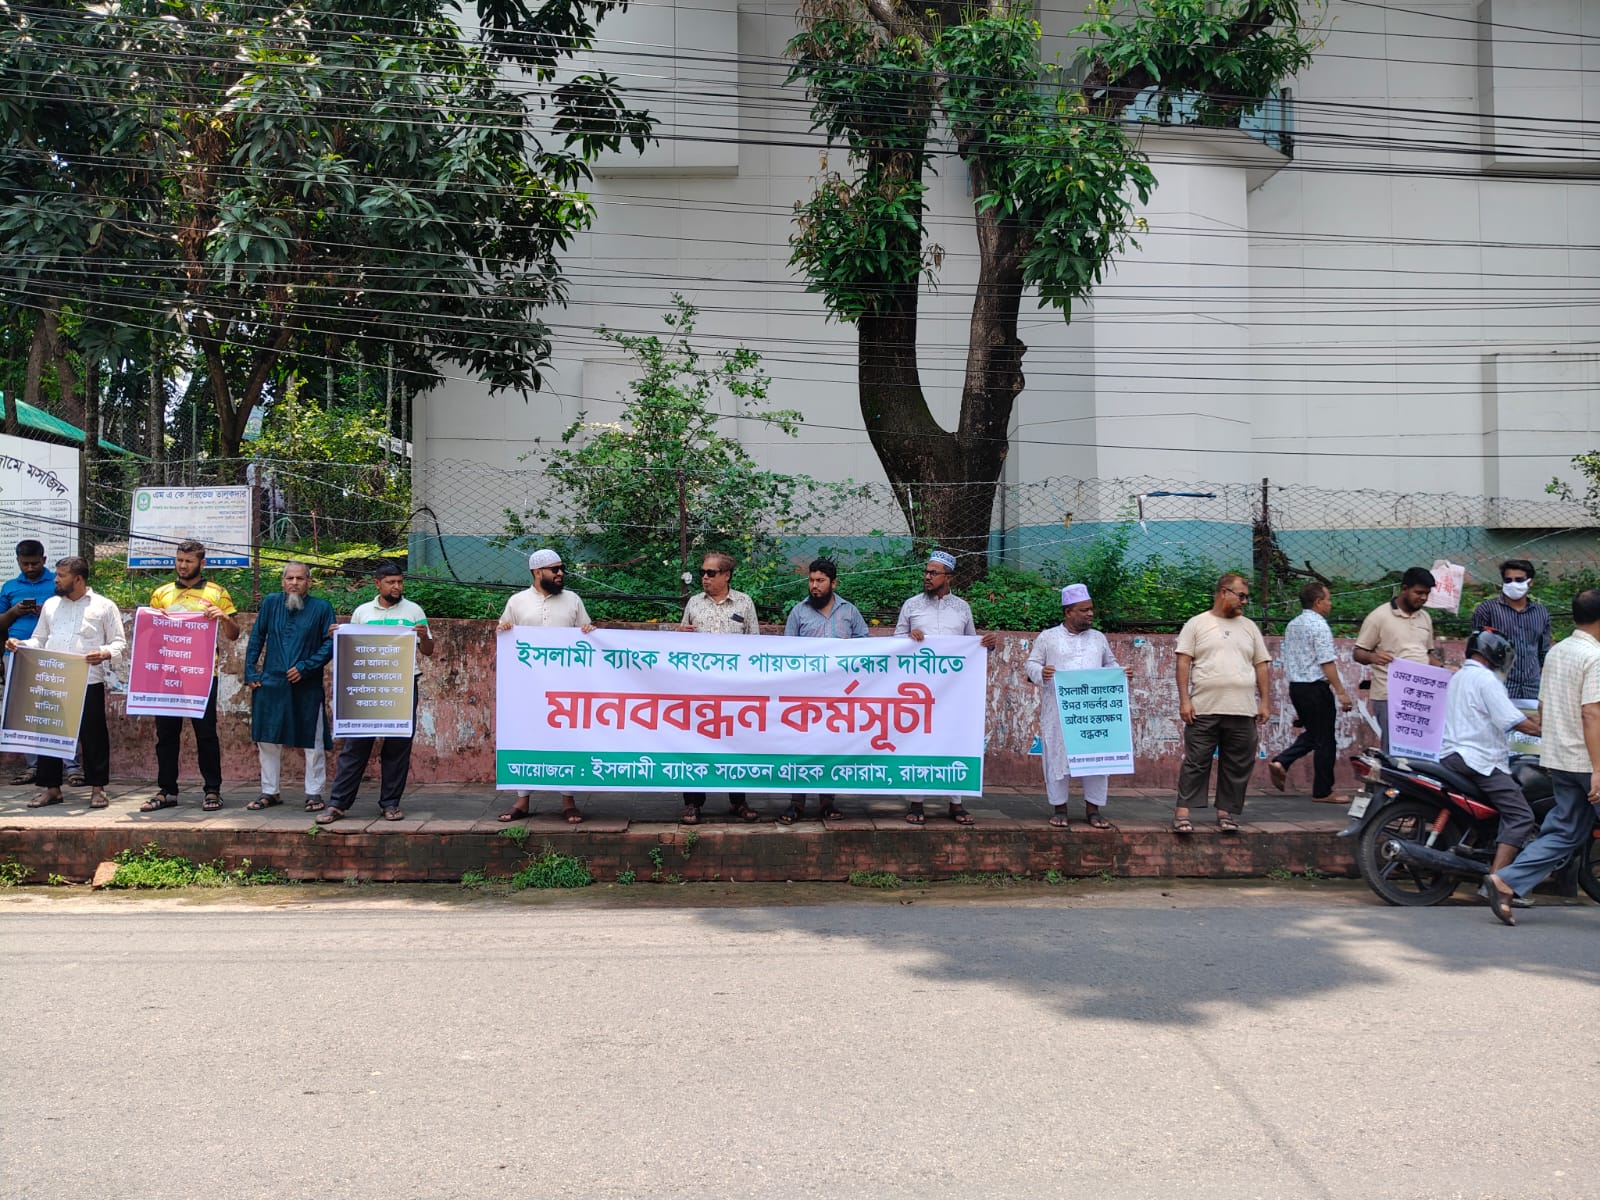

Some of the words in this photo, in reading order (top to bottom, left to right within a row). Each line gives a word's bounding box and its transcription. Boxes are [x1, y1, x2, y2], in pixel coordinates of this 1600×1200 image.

[27, 464, 69, 498] মসজিদ
[185, 620, 209, 631] ব্যাংক
[163, 634, 192, 644] দখলের
[515, 640, 596, 669] ইসলামী
[602, 649, 660, 671] ব্যাংক
[668, 650, 740, 673] ধ্বংসের
[748, 652, 829, 674] পায়তারা
[835, 654, 891, 675] বন্ধের
[897, 648, 966, 675] দাবীতে
[180, 664, 205, 675] করতে
[1392, 671, 1412, 681] ওমর
[1058, 684, 1089, 697] ইসলামী
[1090, 684, 1124, 695] ব্যাংকের
[1062, 700, 1080, 711] উপর
[1082, 697, 1108, 709] গভর্নর
[1109, 699, 1123, 709] এর
[545, 691, 770, 740] মানববন্ধন
[778, 679, 936, 752] কর্মসূচী
[1064, 714, 1088, 725] অবৈধ
[1090, 713, 1123, 725] হস্তক্ষেপ
[508, 763, 576, 779] আয়োজনে
[591, 755, 656, 780] ইসলামী
[661, 762, 710, 781] ব্যাংক
[716, 762, 774, 781] সচেতন
[777, 762, 825, 782] গ্রাহক
[831, 763, 893, 785] ফোরাম,
[899, 760, 969, 784] রাঙ্গামাটি
